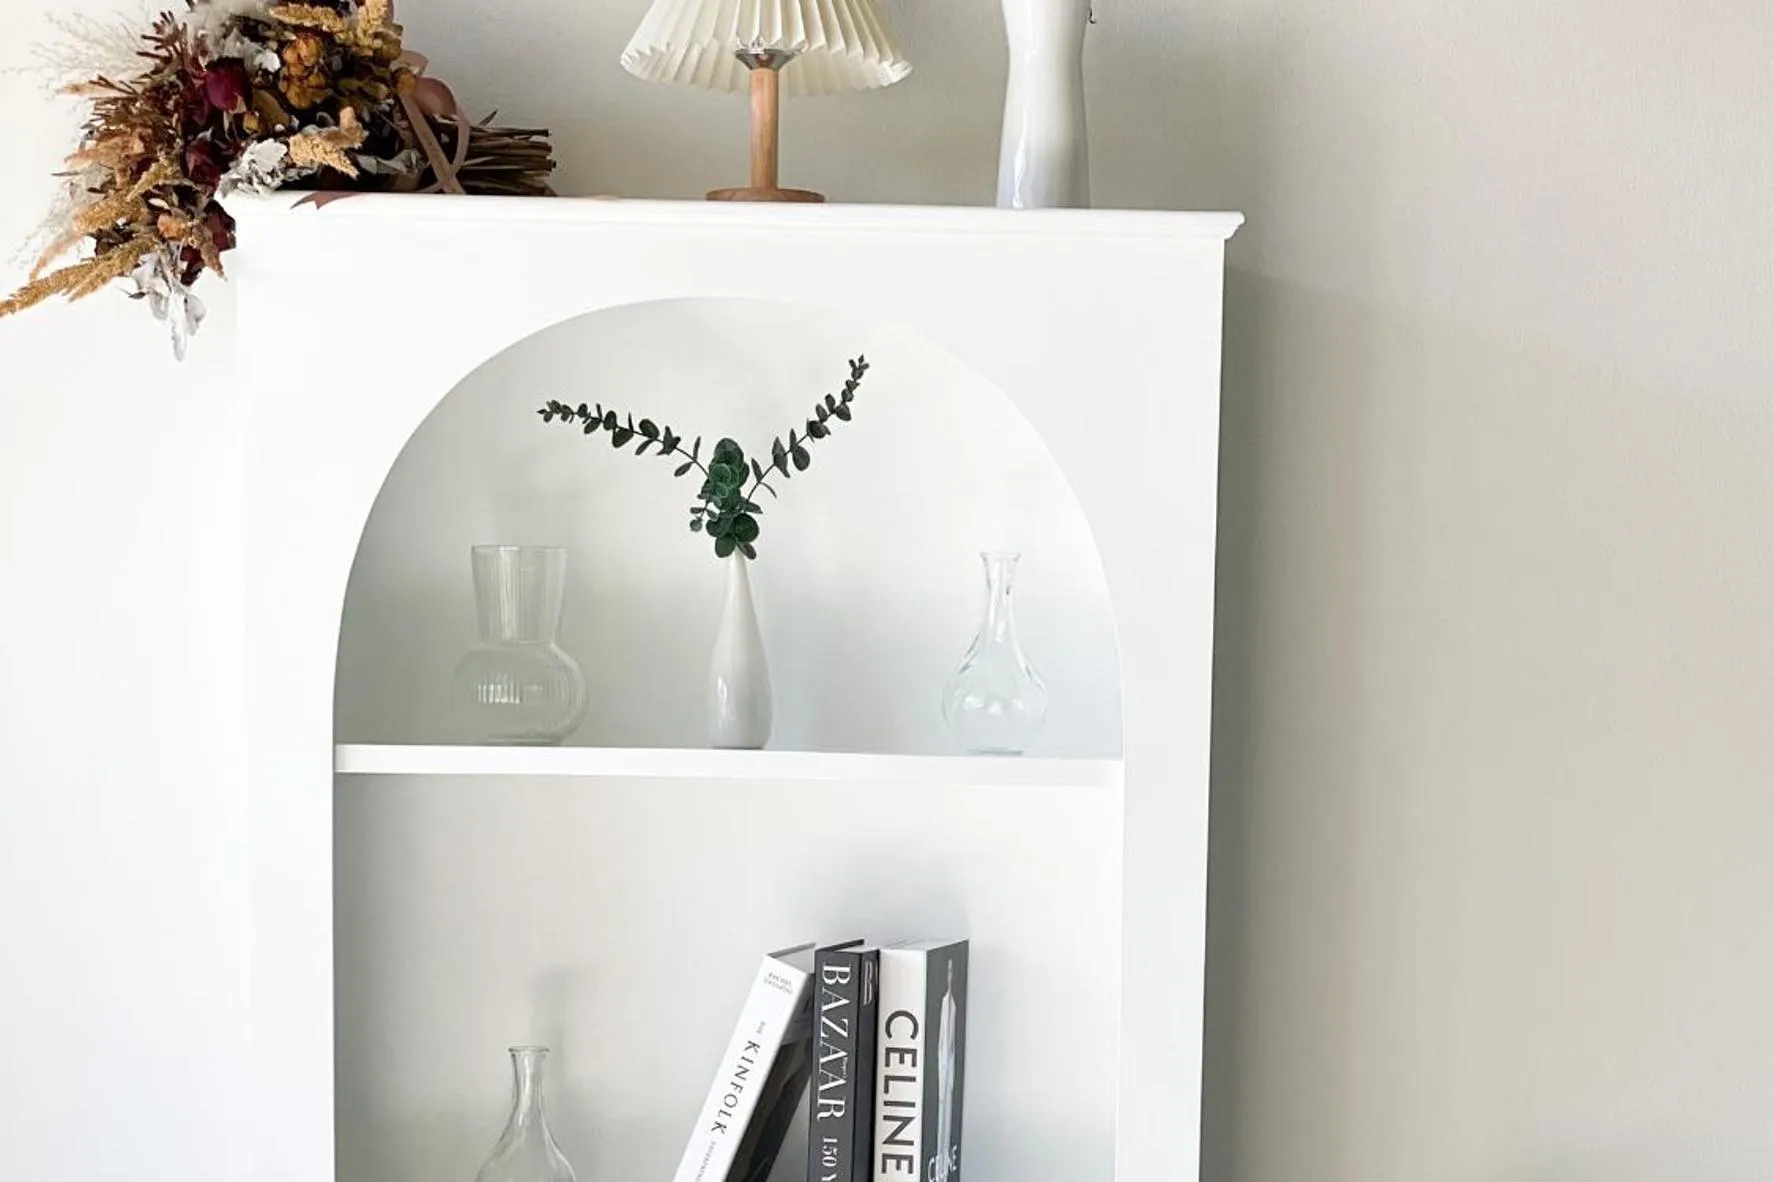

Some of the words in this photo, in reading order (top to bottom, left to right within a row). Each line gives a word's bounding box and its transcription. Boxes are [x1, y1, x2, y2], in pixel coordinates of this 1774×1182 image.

[710, 1039, 761, 1135] KINFOLK
[816, 961, 852, 1121] BAZAAR
[881, 1010, 920, 1174] CELINE
[820, 1137, 838, 1167] 150
